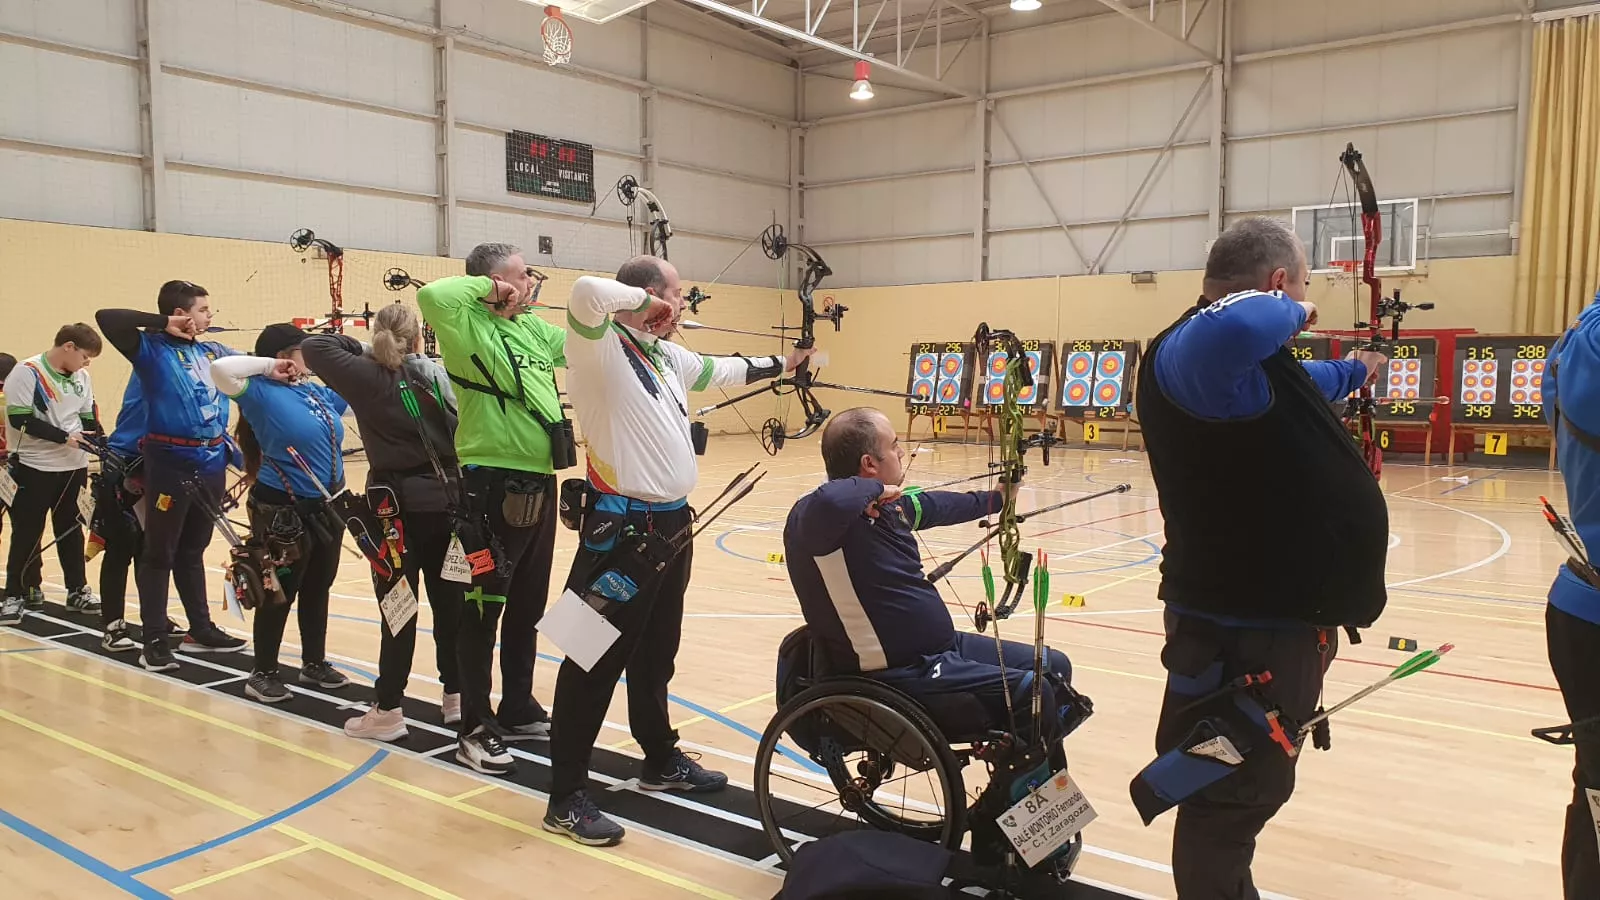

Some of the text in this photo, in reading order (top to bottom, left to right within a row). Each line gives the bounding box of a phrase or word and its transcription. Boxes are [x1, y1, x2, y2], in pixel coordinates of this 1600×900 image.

[514, 161, 589, 183] LOCAL VISITANTE
[1021, 340, 1039, 351] 303
[1073, 340, 1091, 352] 266
[1103, 340, 1122, 350] 274
[1393, 345, 1417, 359] 307
[1517, 345, 1546, 359] 288
[1468, 346, 1494, 360] 315
[939, 405, 955, 416] 227
[1099, 406, 1116, 417] 127
[1390, 400, 1415, 414] 345
[1465, 404, 1492, 418] 349
[1513, 404, 1541, 418] 342
[936, 416, 942, 432] 1
[1088, 424, 1095, 440] 3
[1380, 430, 1389, 448] 6
[1491, 435, 1501, 453] 7
[770, 554, 777, 562] 5
[1069, 595, 1076, 606] 7
[1397, 638, 1406, 650] 8
[1025, 792, 1049, 814] 8A
[1013, 828, 1032, 847] GALÉ
[1028, 807, 1060, 838] MONTORIO
[1056, 791, 1083, 814] Fernando
